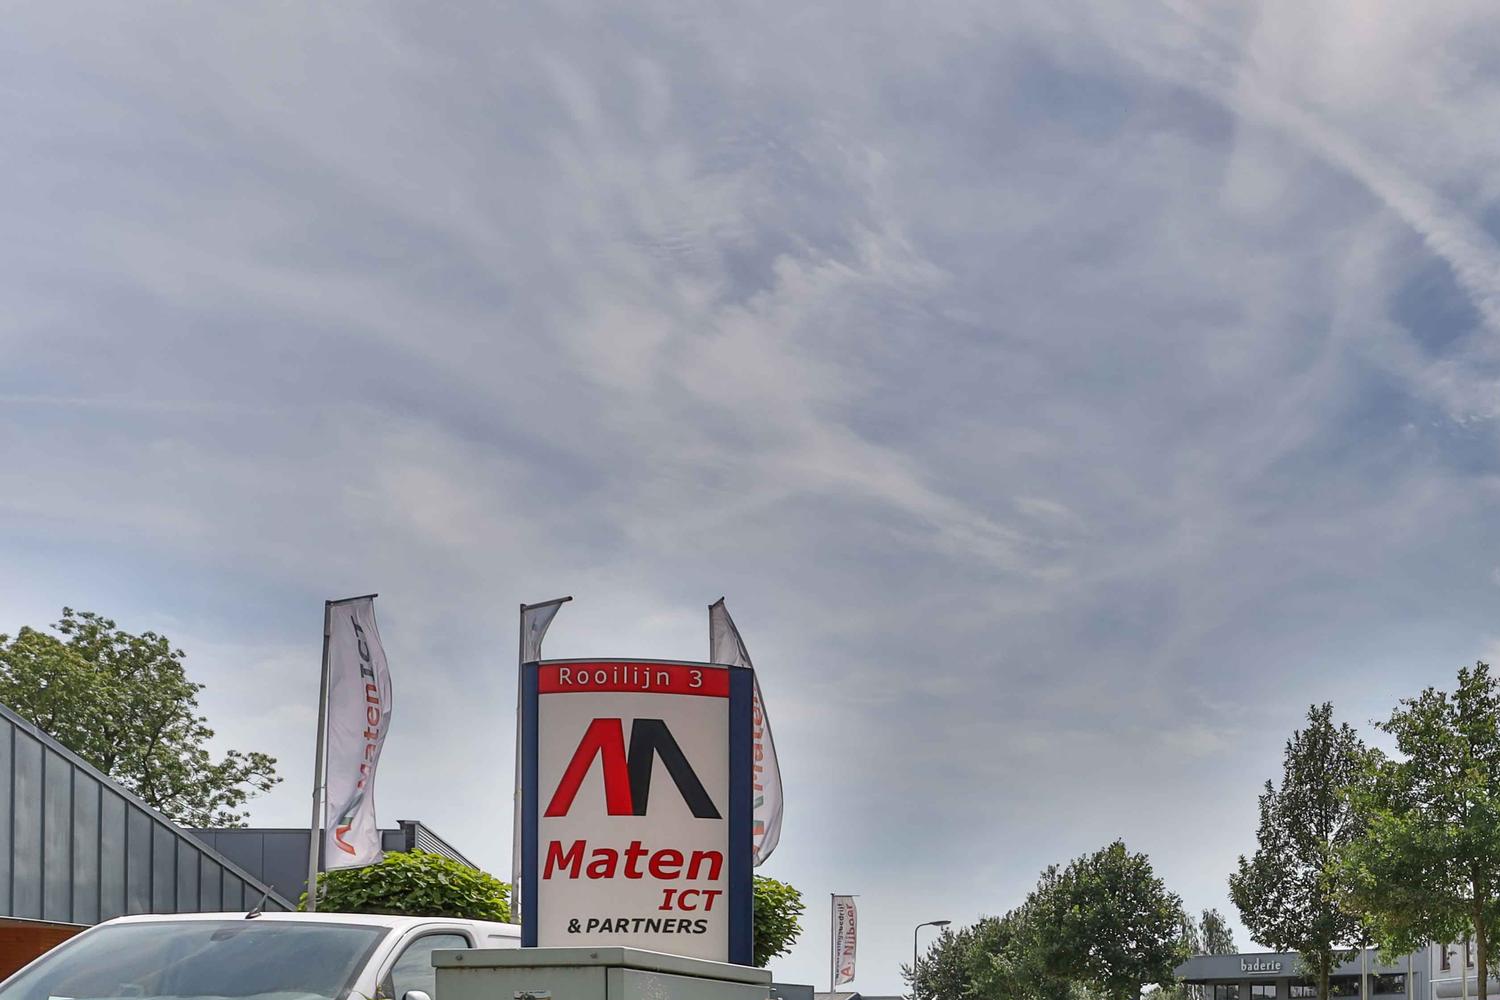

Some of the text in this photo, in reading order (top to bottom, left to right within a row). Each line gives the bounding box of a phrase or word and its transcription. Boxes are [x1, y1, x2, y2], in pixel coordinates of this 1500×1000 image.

[559, 667, 703, 689] Rooilijn 3
[542, 840, 724, 880] Maten
[658, 889, 723, 911] ICT
[567, 918, 708, 934] & PARTNERS
[1241, 958, 1281, 971] baderie
